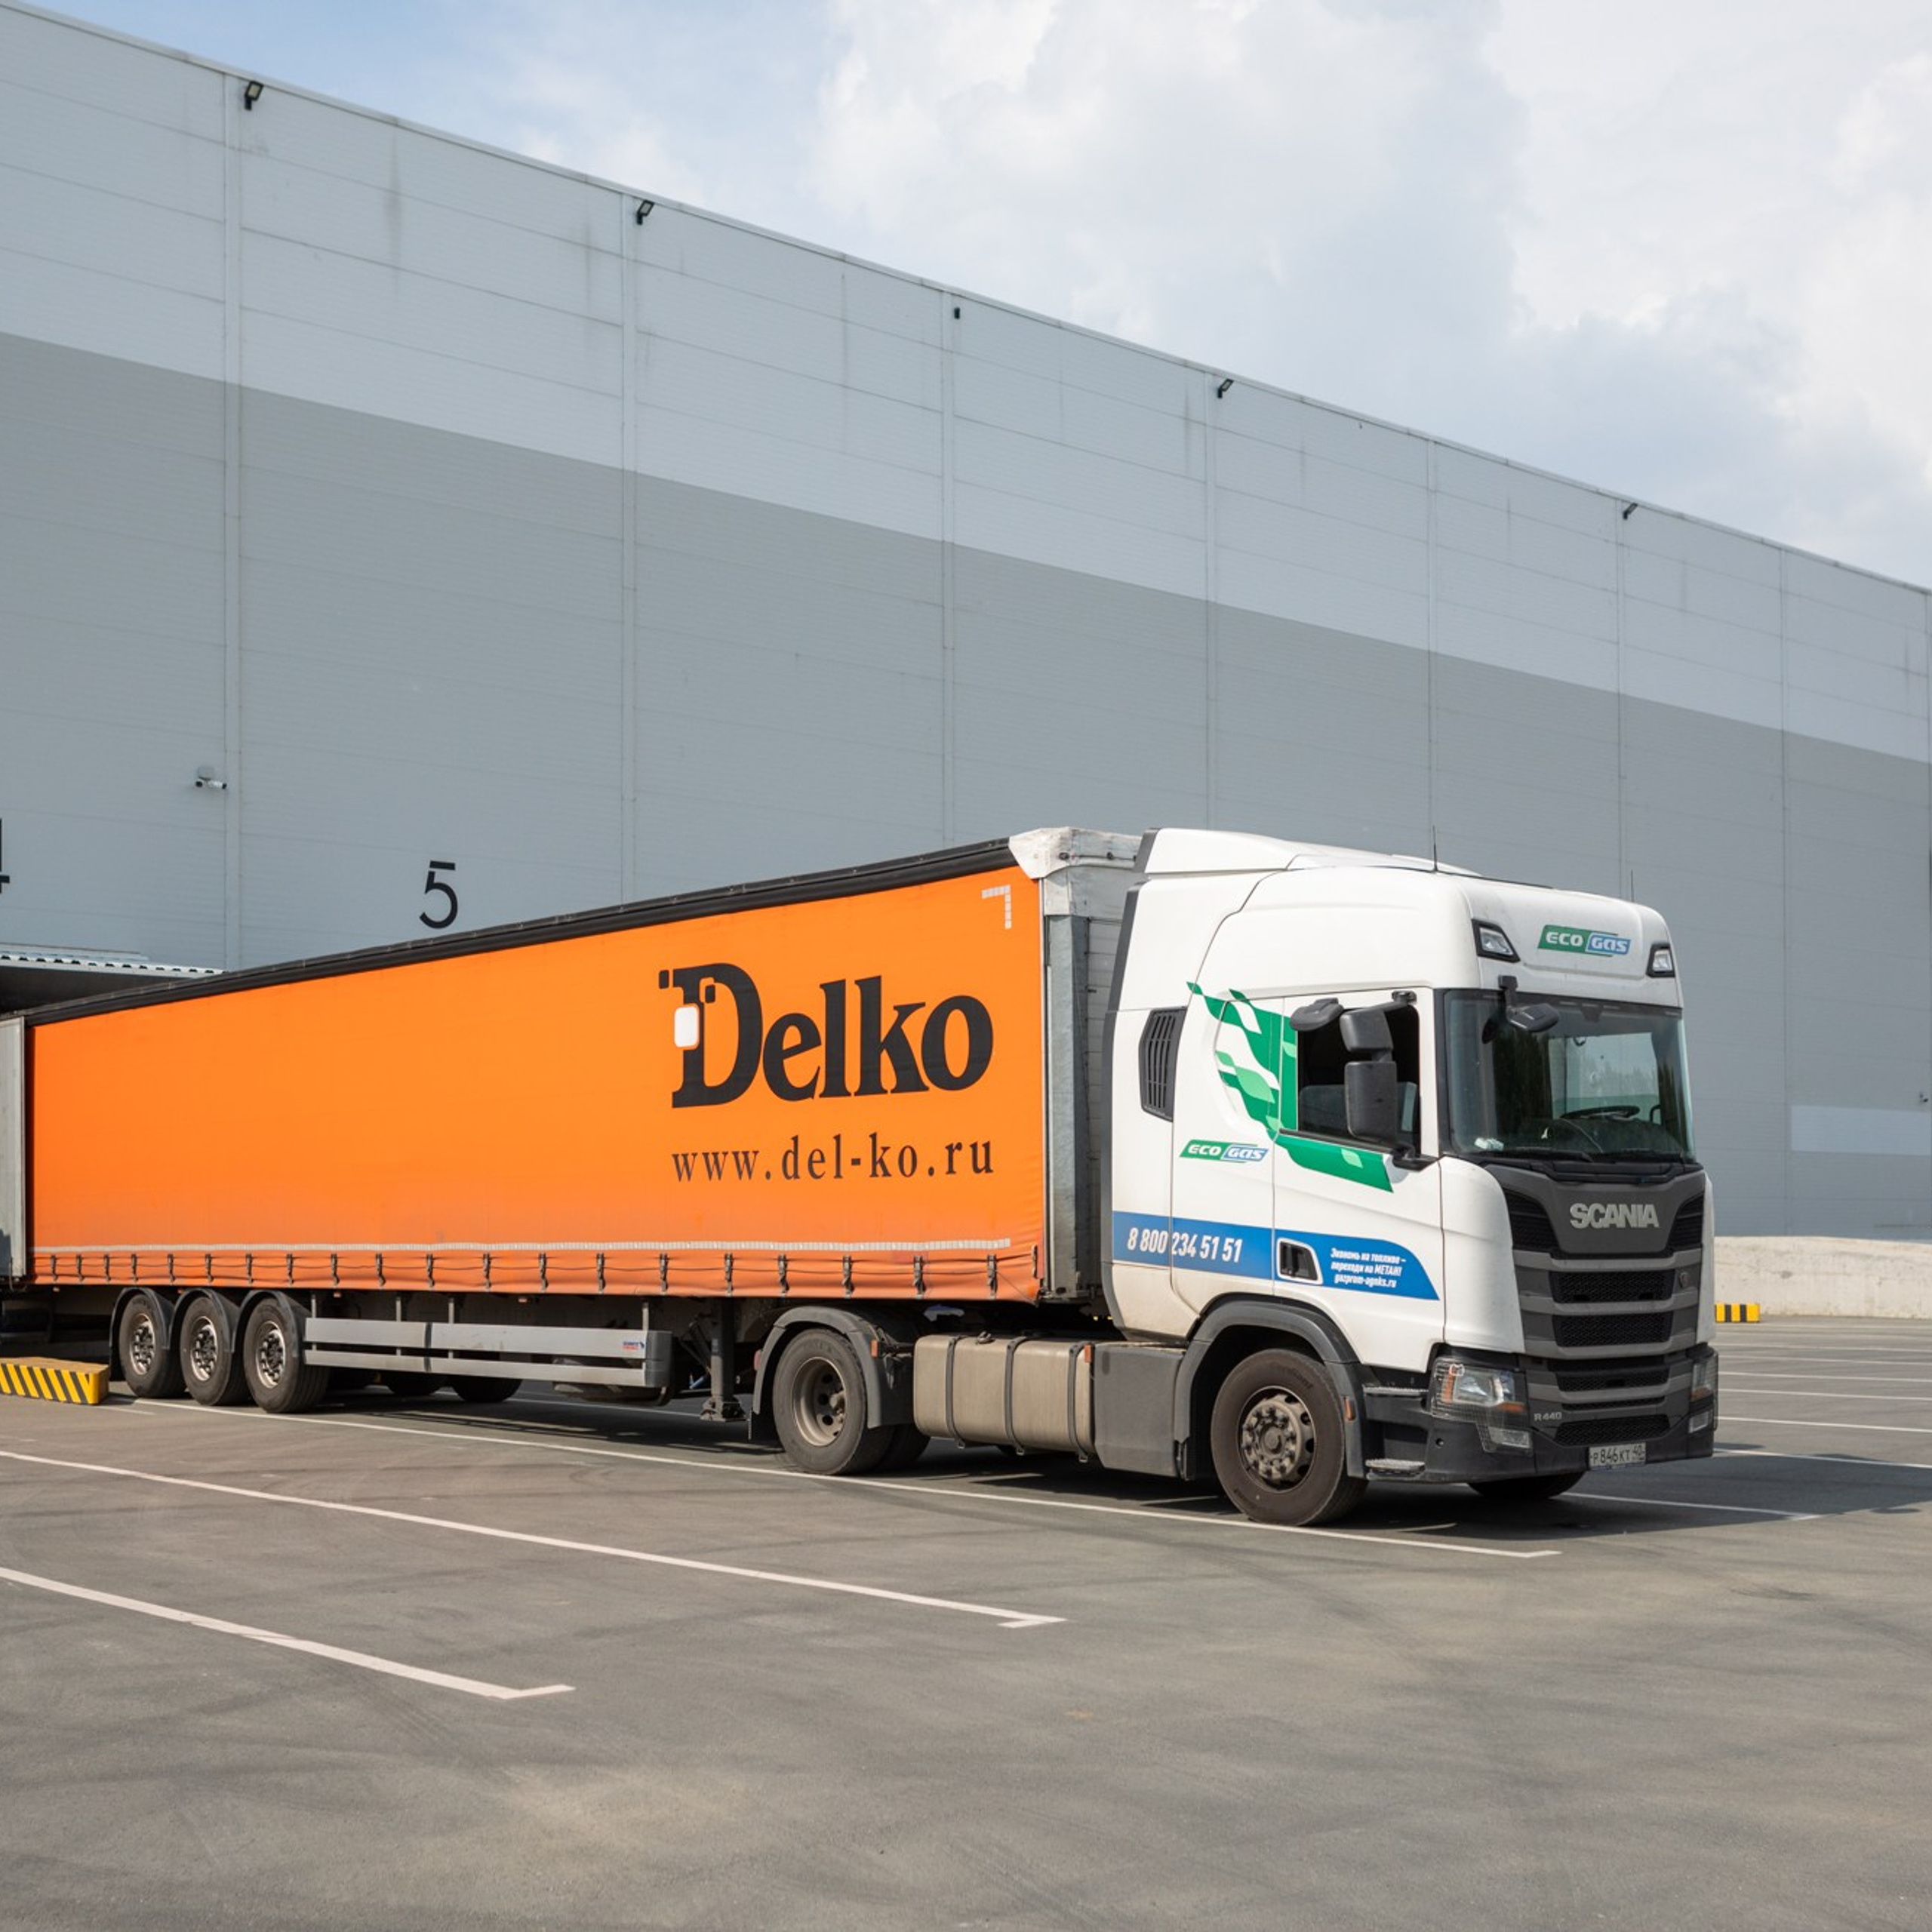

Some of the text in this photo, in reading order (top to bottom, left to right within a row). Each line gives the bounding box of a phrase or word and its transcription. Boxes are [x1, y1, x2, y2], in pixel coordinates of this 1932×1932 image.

[420, 860, 458, 929] 5
[668, 963, 993, 1108] Delko
[671, 1132, 994, 1183] www.del-ko.ru
[1570, 1202, 1660, 1229] SCANIA
[1127, 1227, 1243, 1263] 8 800 234 51 51
